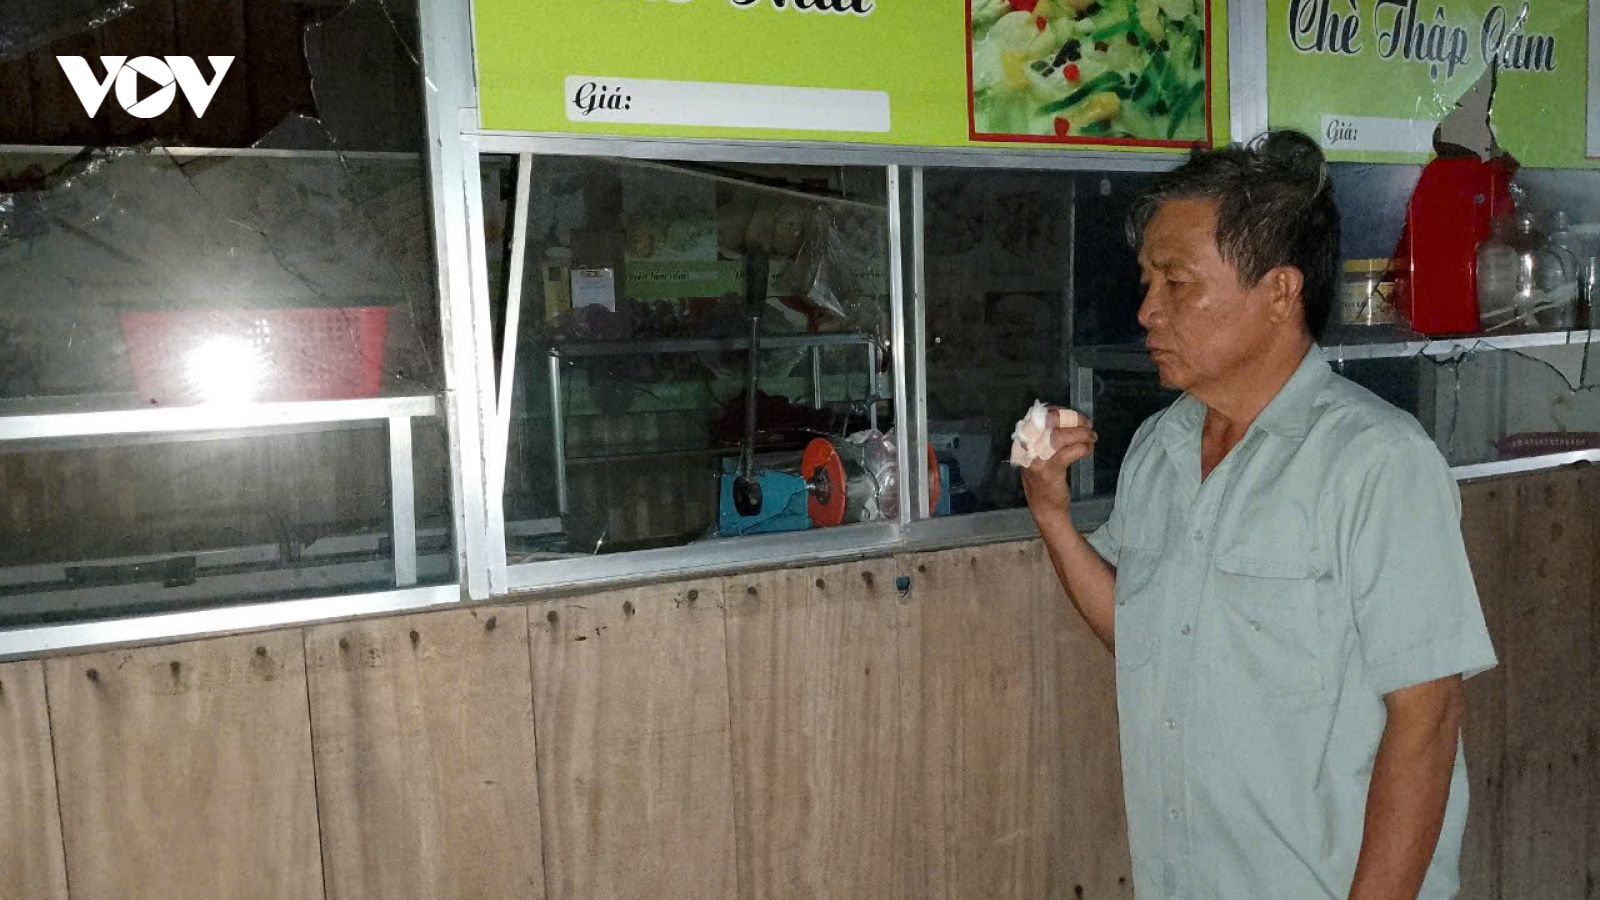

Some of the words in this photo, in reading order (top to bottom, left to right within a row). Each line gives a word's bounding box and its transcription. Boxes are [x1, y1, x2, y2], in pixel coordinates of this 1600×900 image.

[1289, 0, 1362, 54] Chè
[1374, 0, 1471, 79] Thập
[572, 81, 632, 116] Giá:
[1326, 119, 1358, 145] Giá:
